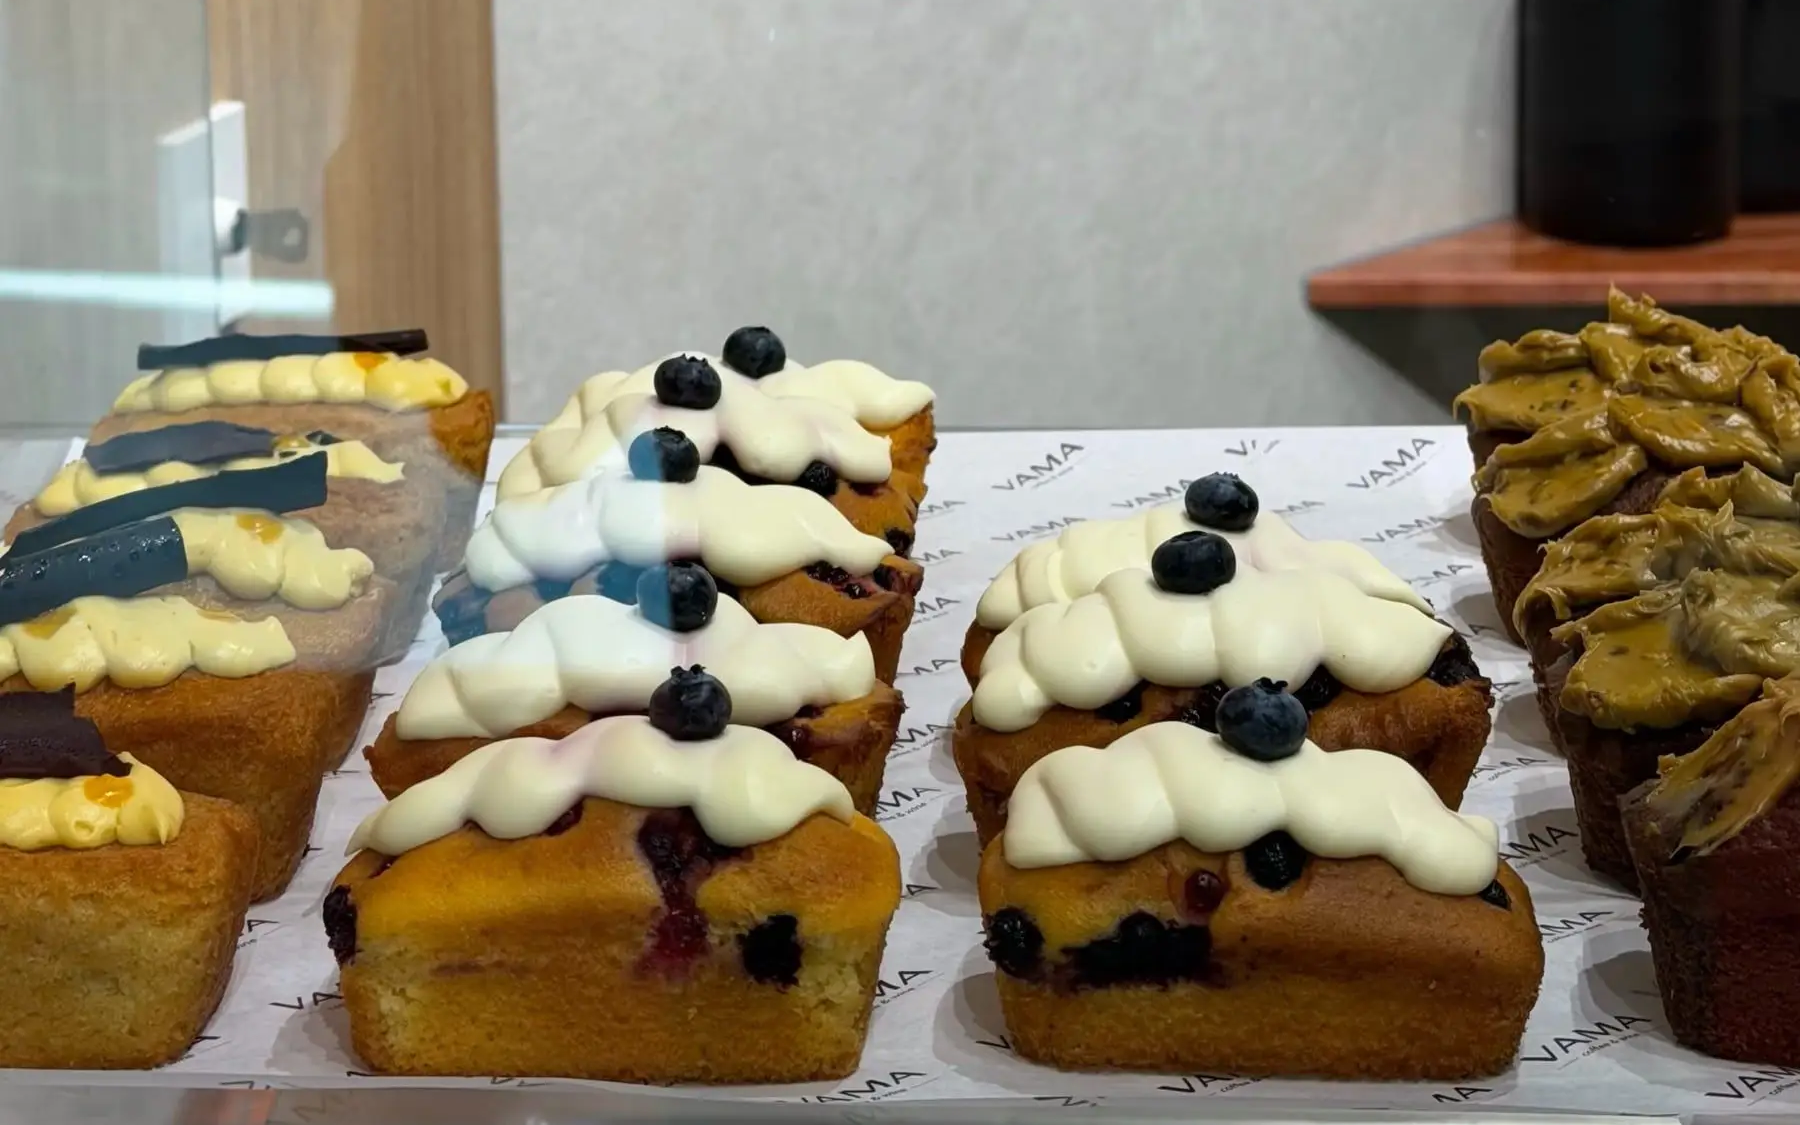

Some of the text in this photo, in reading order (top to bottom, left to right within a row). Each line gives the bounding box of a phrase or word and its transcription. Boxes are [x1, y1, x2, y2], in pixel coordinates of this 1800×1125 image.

[991, 442, 1085, 491] VAMA
[1345, 437, 1436, 489] VAMA
[990, 516, 1087, 543] VAMA
[1498, 826, 1579, 860] AMA
[1520, 1015, 1652, 1062] VAMA
[801, 1071, 927, 1103] AMA
